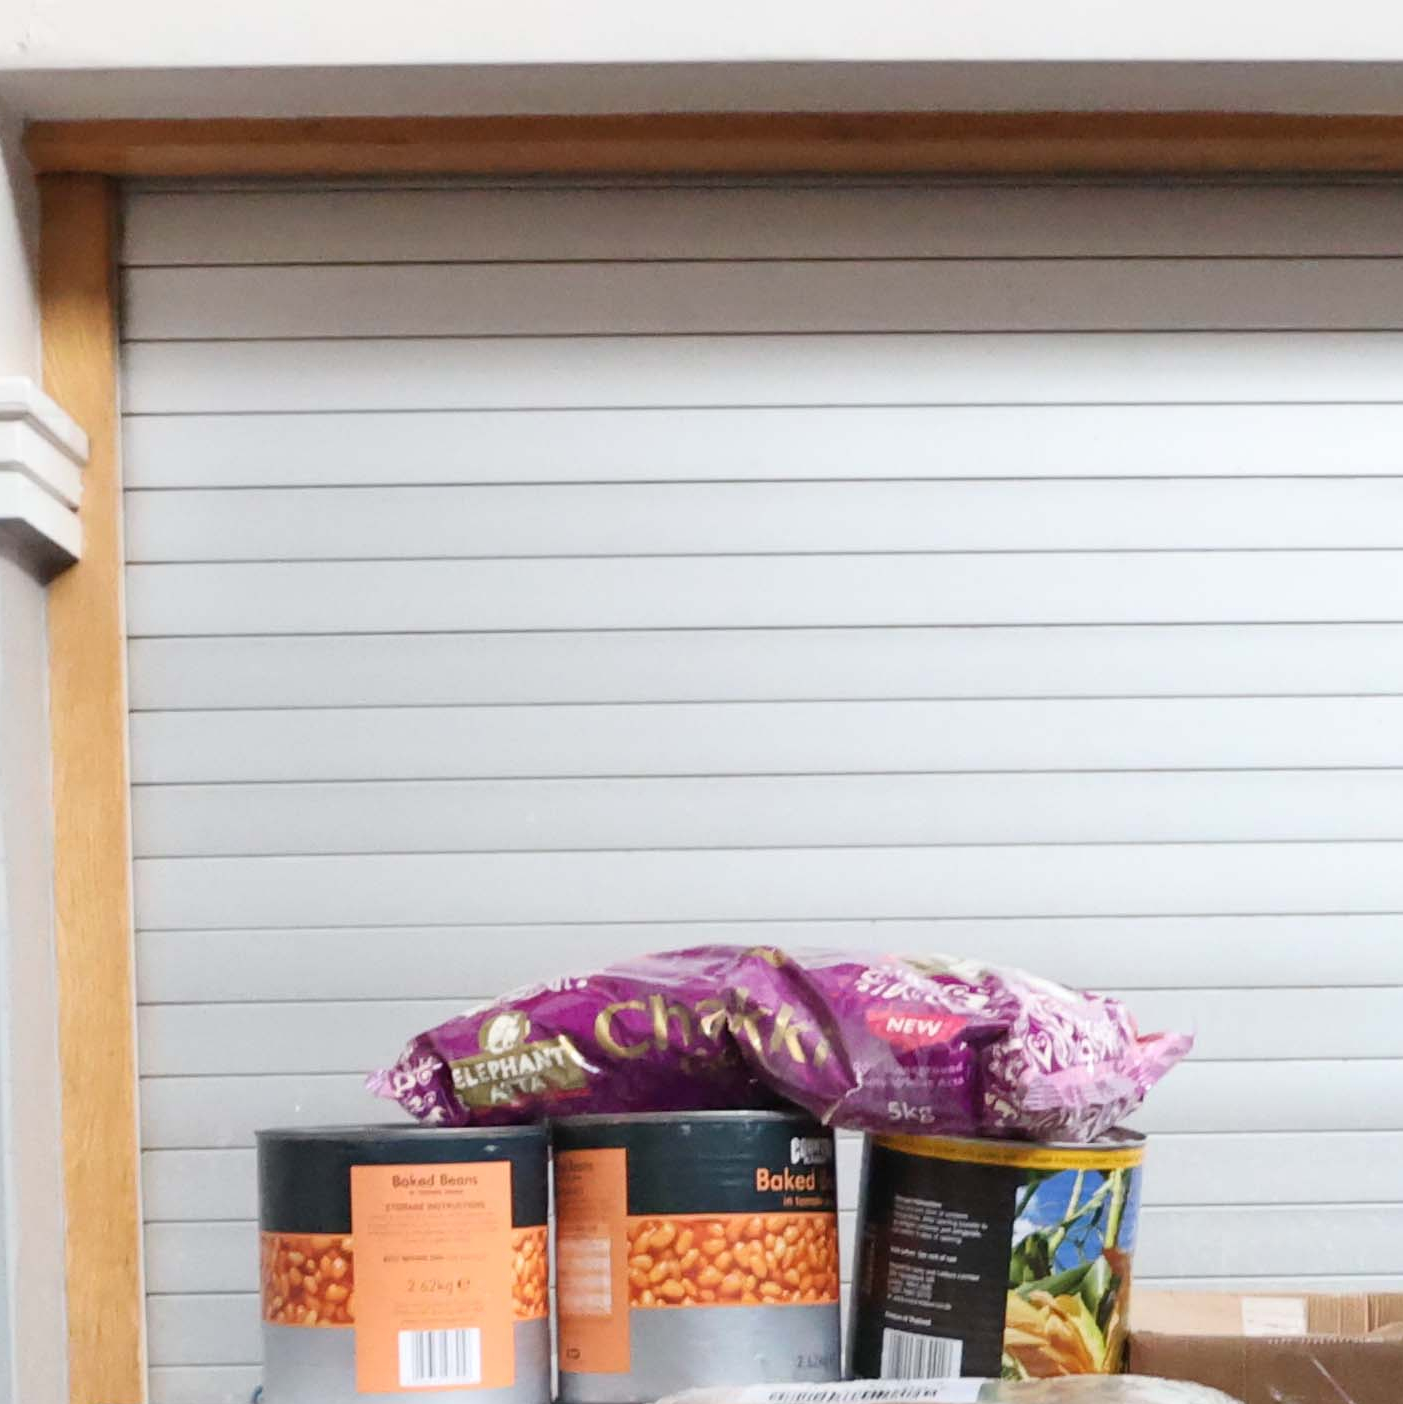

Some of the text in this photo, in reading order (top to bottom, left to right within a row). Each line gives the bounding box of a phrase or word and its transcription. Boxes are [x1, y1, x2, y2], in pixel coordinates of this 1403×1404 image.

[886, 1016, 943, 1037] NEW
[453, 1047, 567, 1090] ELEPHANT
[887, 1101, 936, 1124] 5kg
[392, 1173, 478, 1188] Baked Beans
[756, 1167, 815, 1192] Baked
